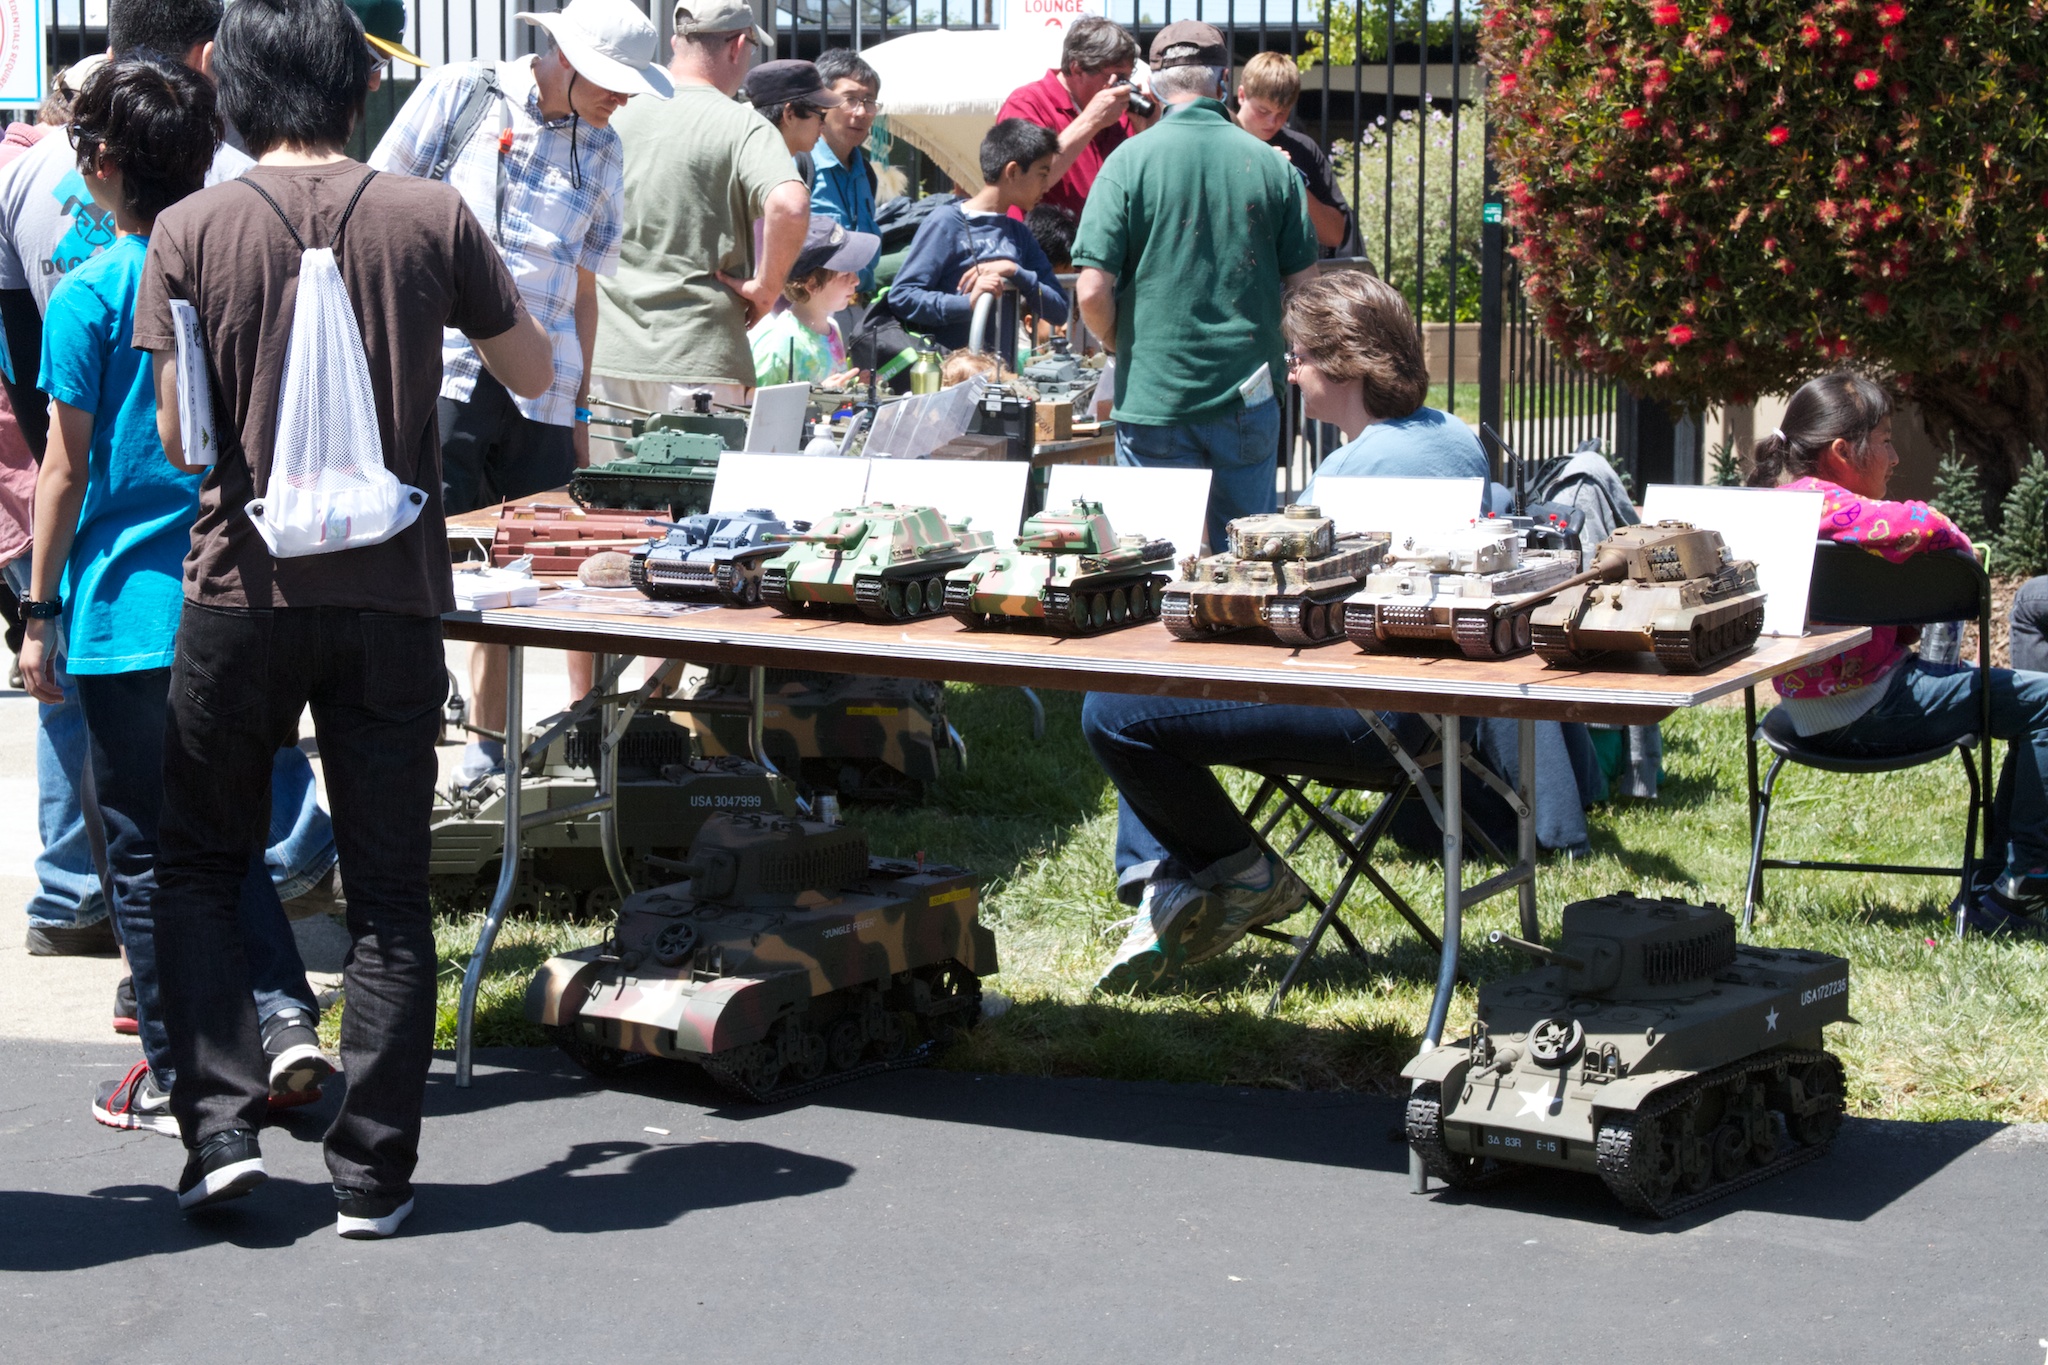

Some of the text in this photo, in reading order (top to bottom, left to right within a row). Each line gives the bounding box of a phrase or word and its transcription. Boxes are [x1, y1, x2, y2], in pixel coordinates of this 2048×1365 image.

[1025, 0, 1084, 13] LOUNGE
[9, 0, 20, 50] EDENTIALS
[690, 796, 762, 807] USA 3047999
